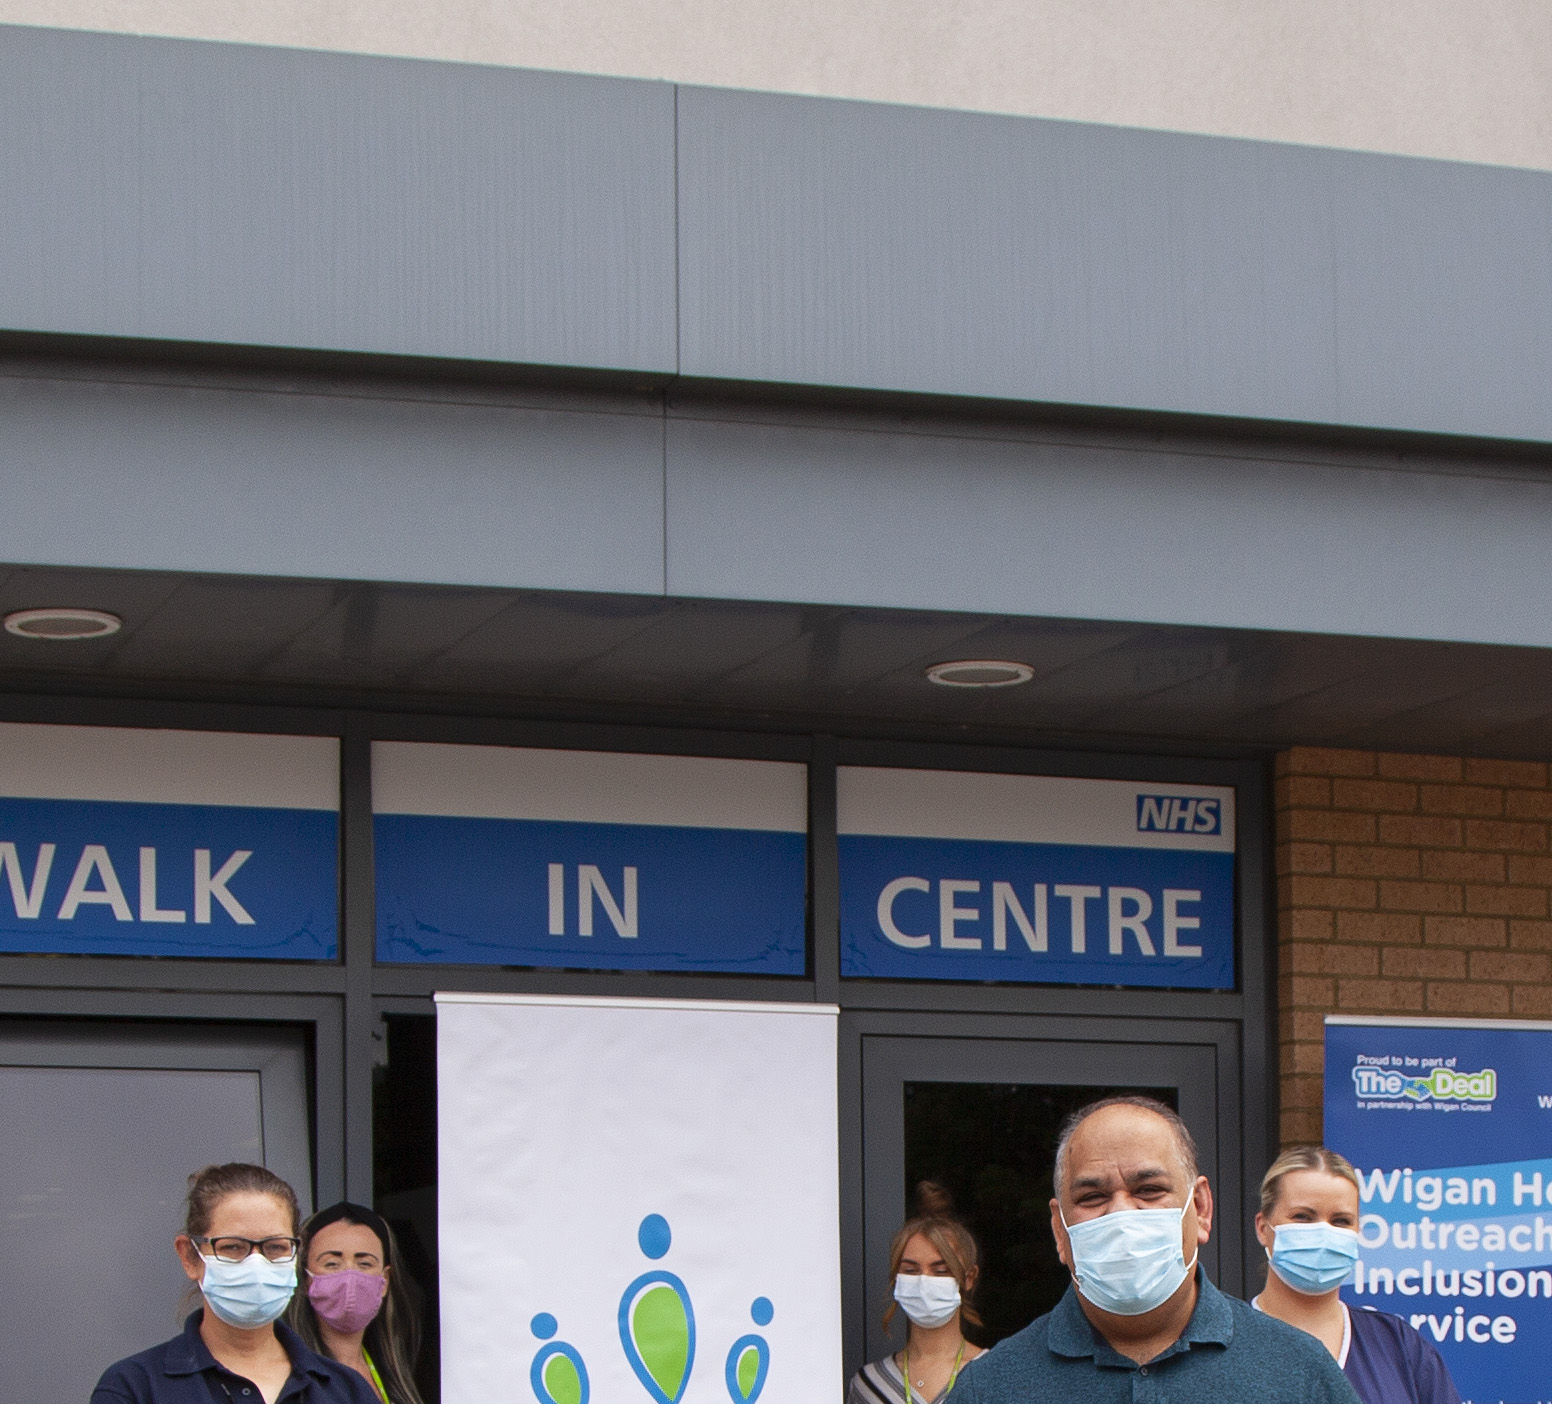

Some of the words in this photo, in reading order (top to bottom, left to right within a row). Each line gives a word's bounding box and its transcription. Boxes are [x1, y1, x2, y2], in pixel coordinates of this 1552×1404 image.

[1138, 798, 1219, 834] NHS
[548, 862, 639, 939] IN
[876, 875, 1203, 958] CENTRE
[1357, 1055, 1390, 1065] Proud
[1391, 1056, 1403, 1066] to
[1405, 1056, 1419, 1066] be
[1421, 1057, 1443, 1068] part
[1445, 1057, 1456, 1067] of
[1358, 1071, 1401, 1093] The
[1436, 1073, 1492, 1095] Deal
[1460, 1103, 1492, 1111] Council
[1354, 1168, 1497, 1211] Wigan
[1354, 1260, 1552, 1298] Inclusion
[1410, 1306, 1517, 1344] rvice
